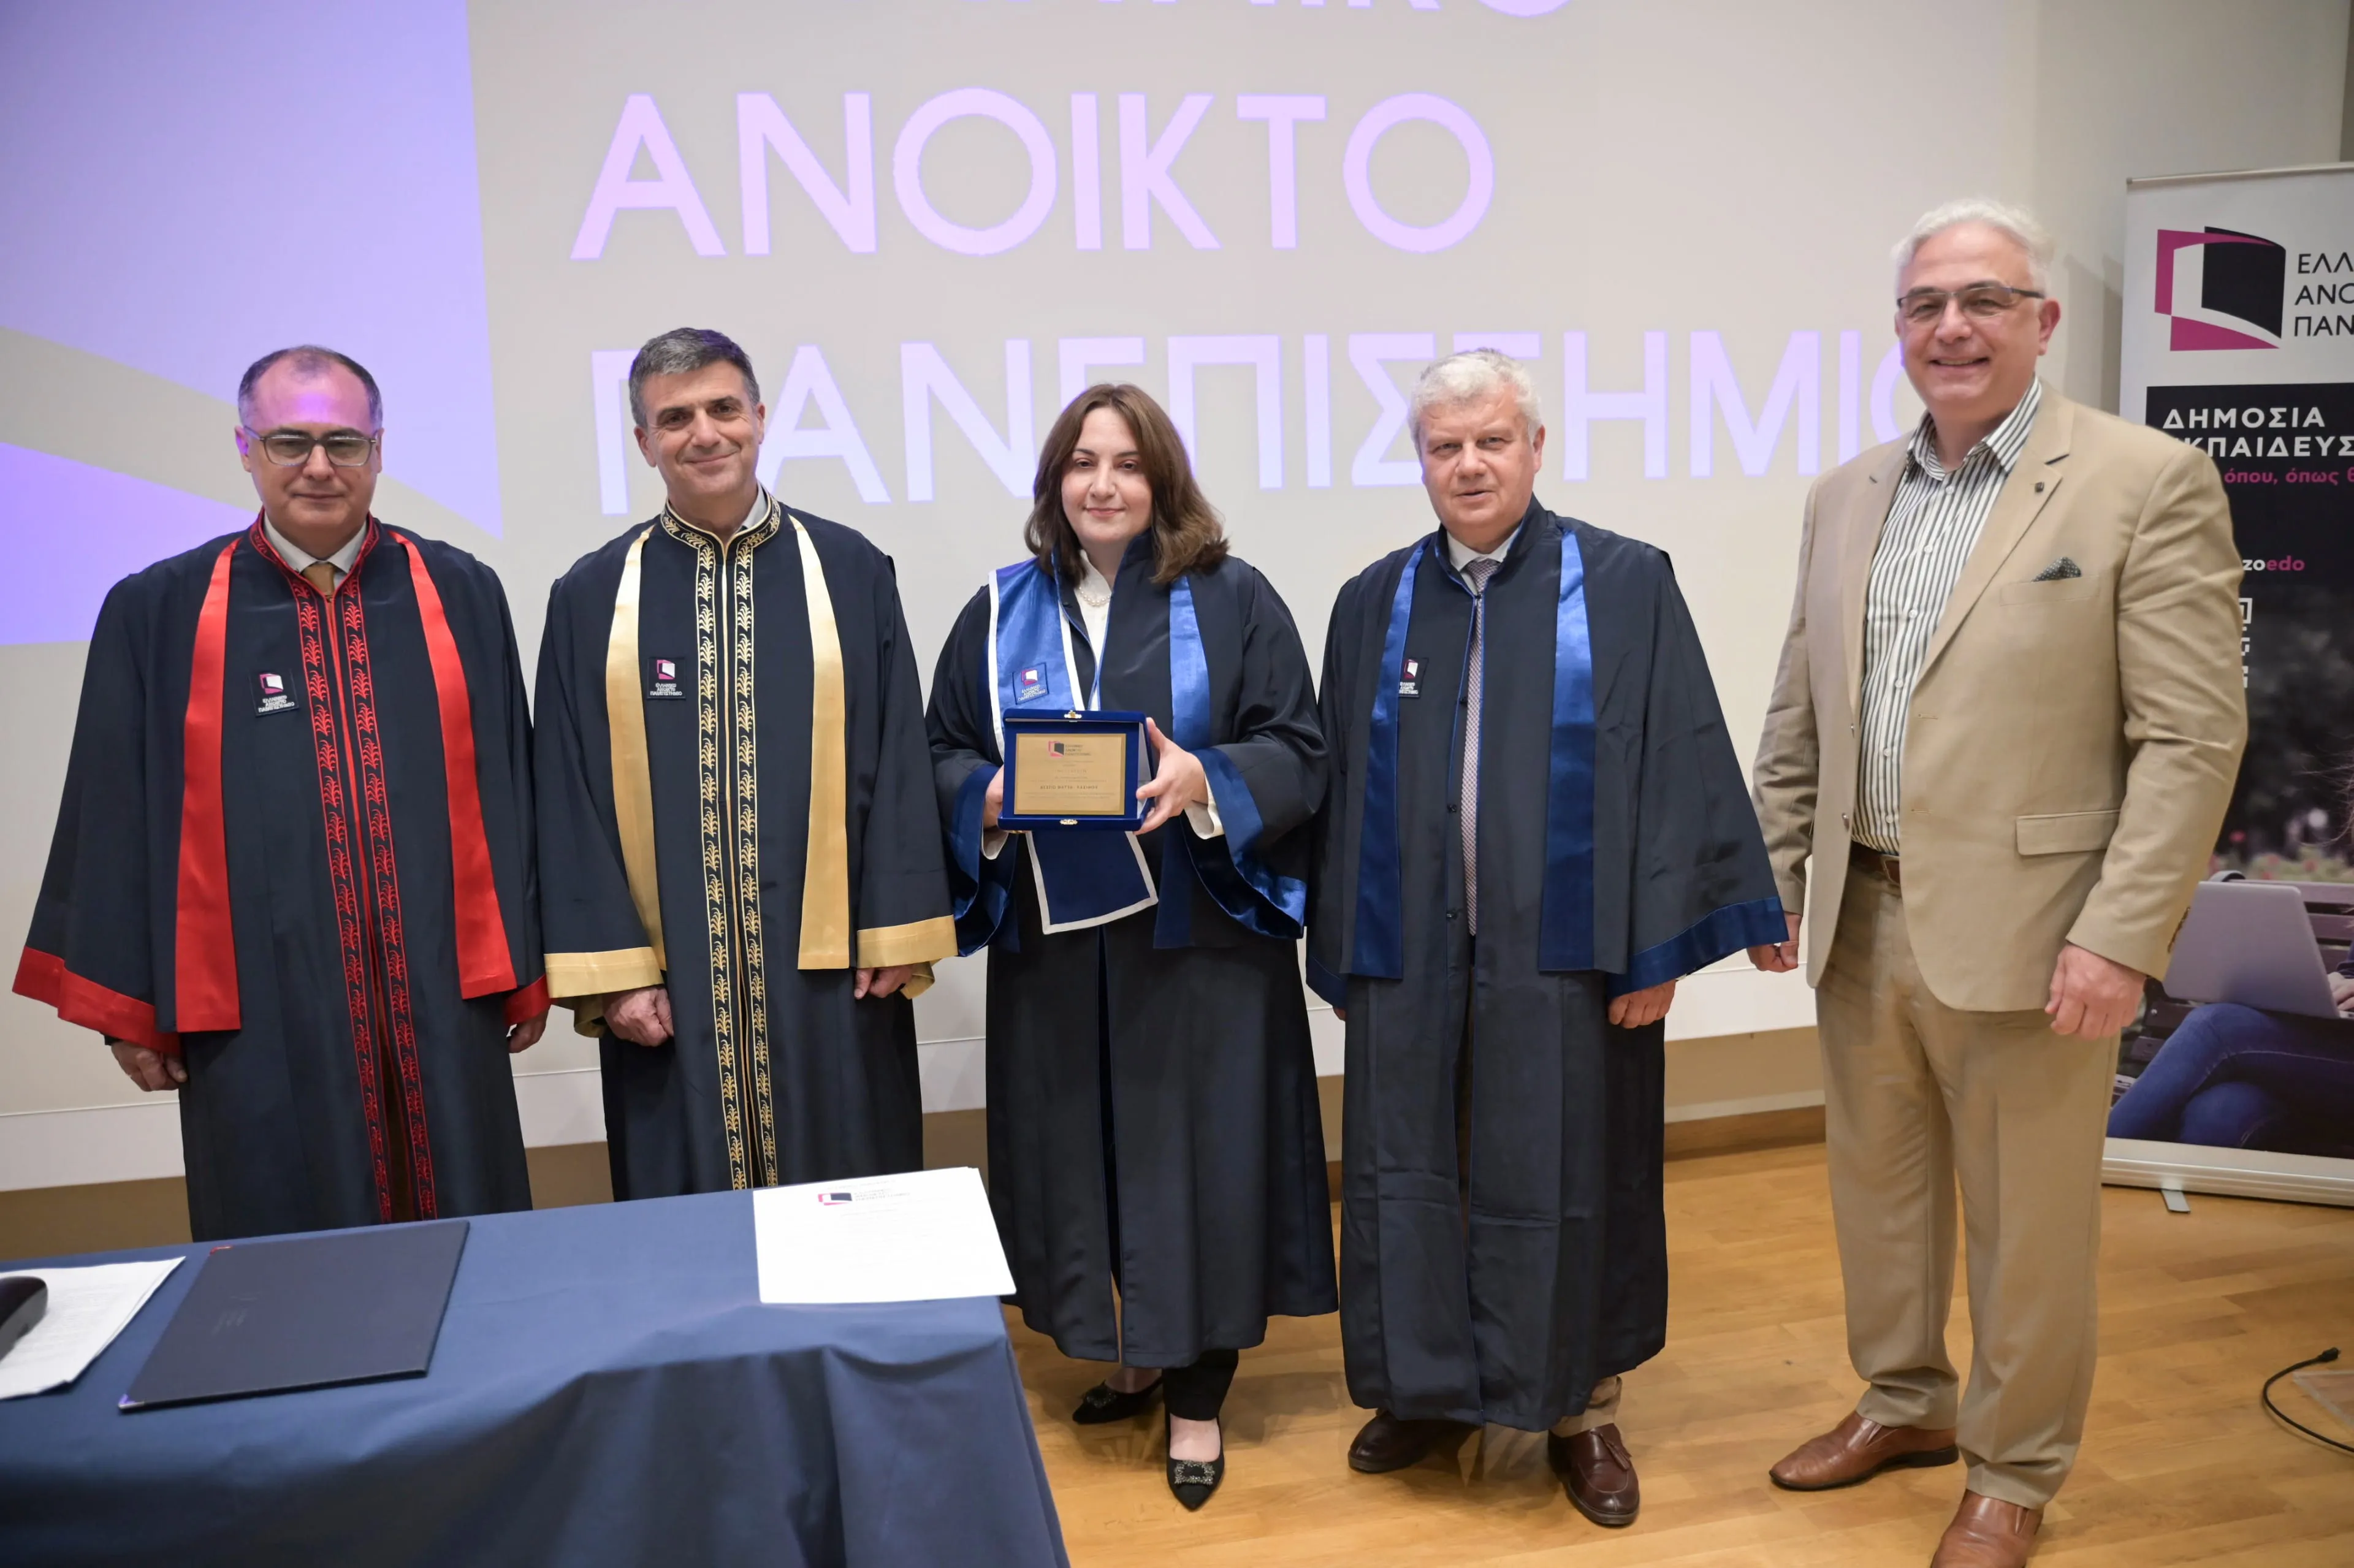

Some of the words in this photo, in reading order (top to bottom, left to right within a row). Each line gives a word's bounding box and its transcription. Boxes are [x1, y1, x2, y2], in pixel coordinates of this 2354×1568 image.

[569, 87, 1496, 261] ΑΝΟΙΚΤΟ
[2298, 252, 2354, 274] ΕΛΛ
[2295, 283, 2354, 305] ΑΝΟ
[2294, 314, 2354, 337] ΠΑΝ
[2162, 407, 2325, 428] ΔΗΜΟΣΙΑ
[2176, 436, 2354, 457] ΠΑΙΔΕΥΣ
[2224, 467, 2278, 485] όπου,
[2285, 467, 2339, 486] όπως
